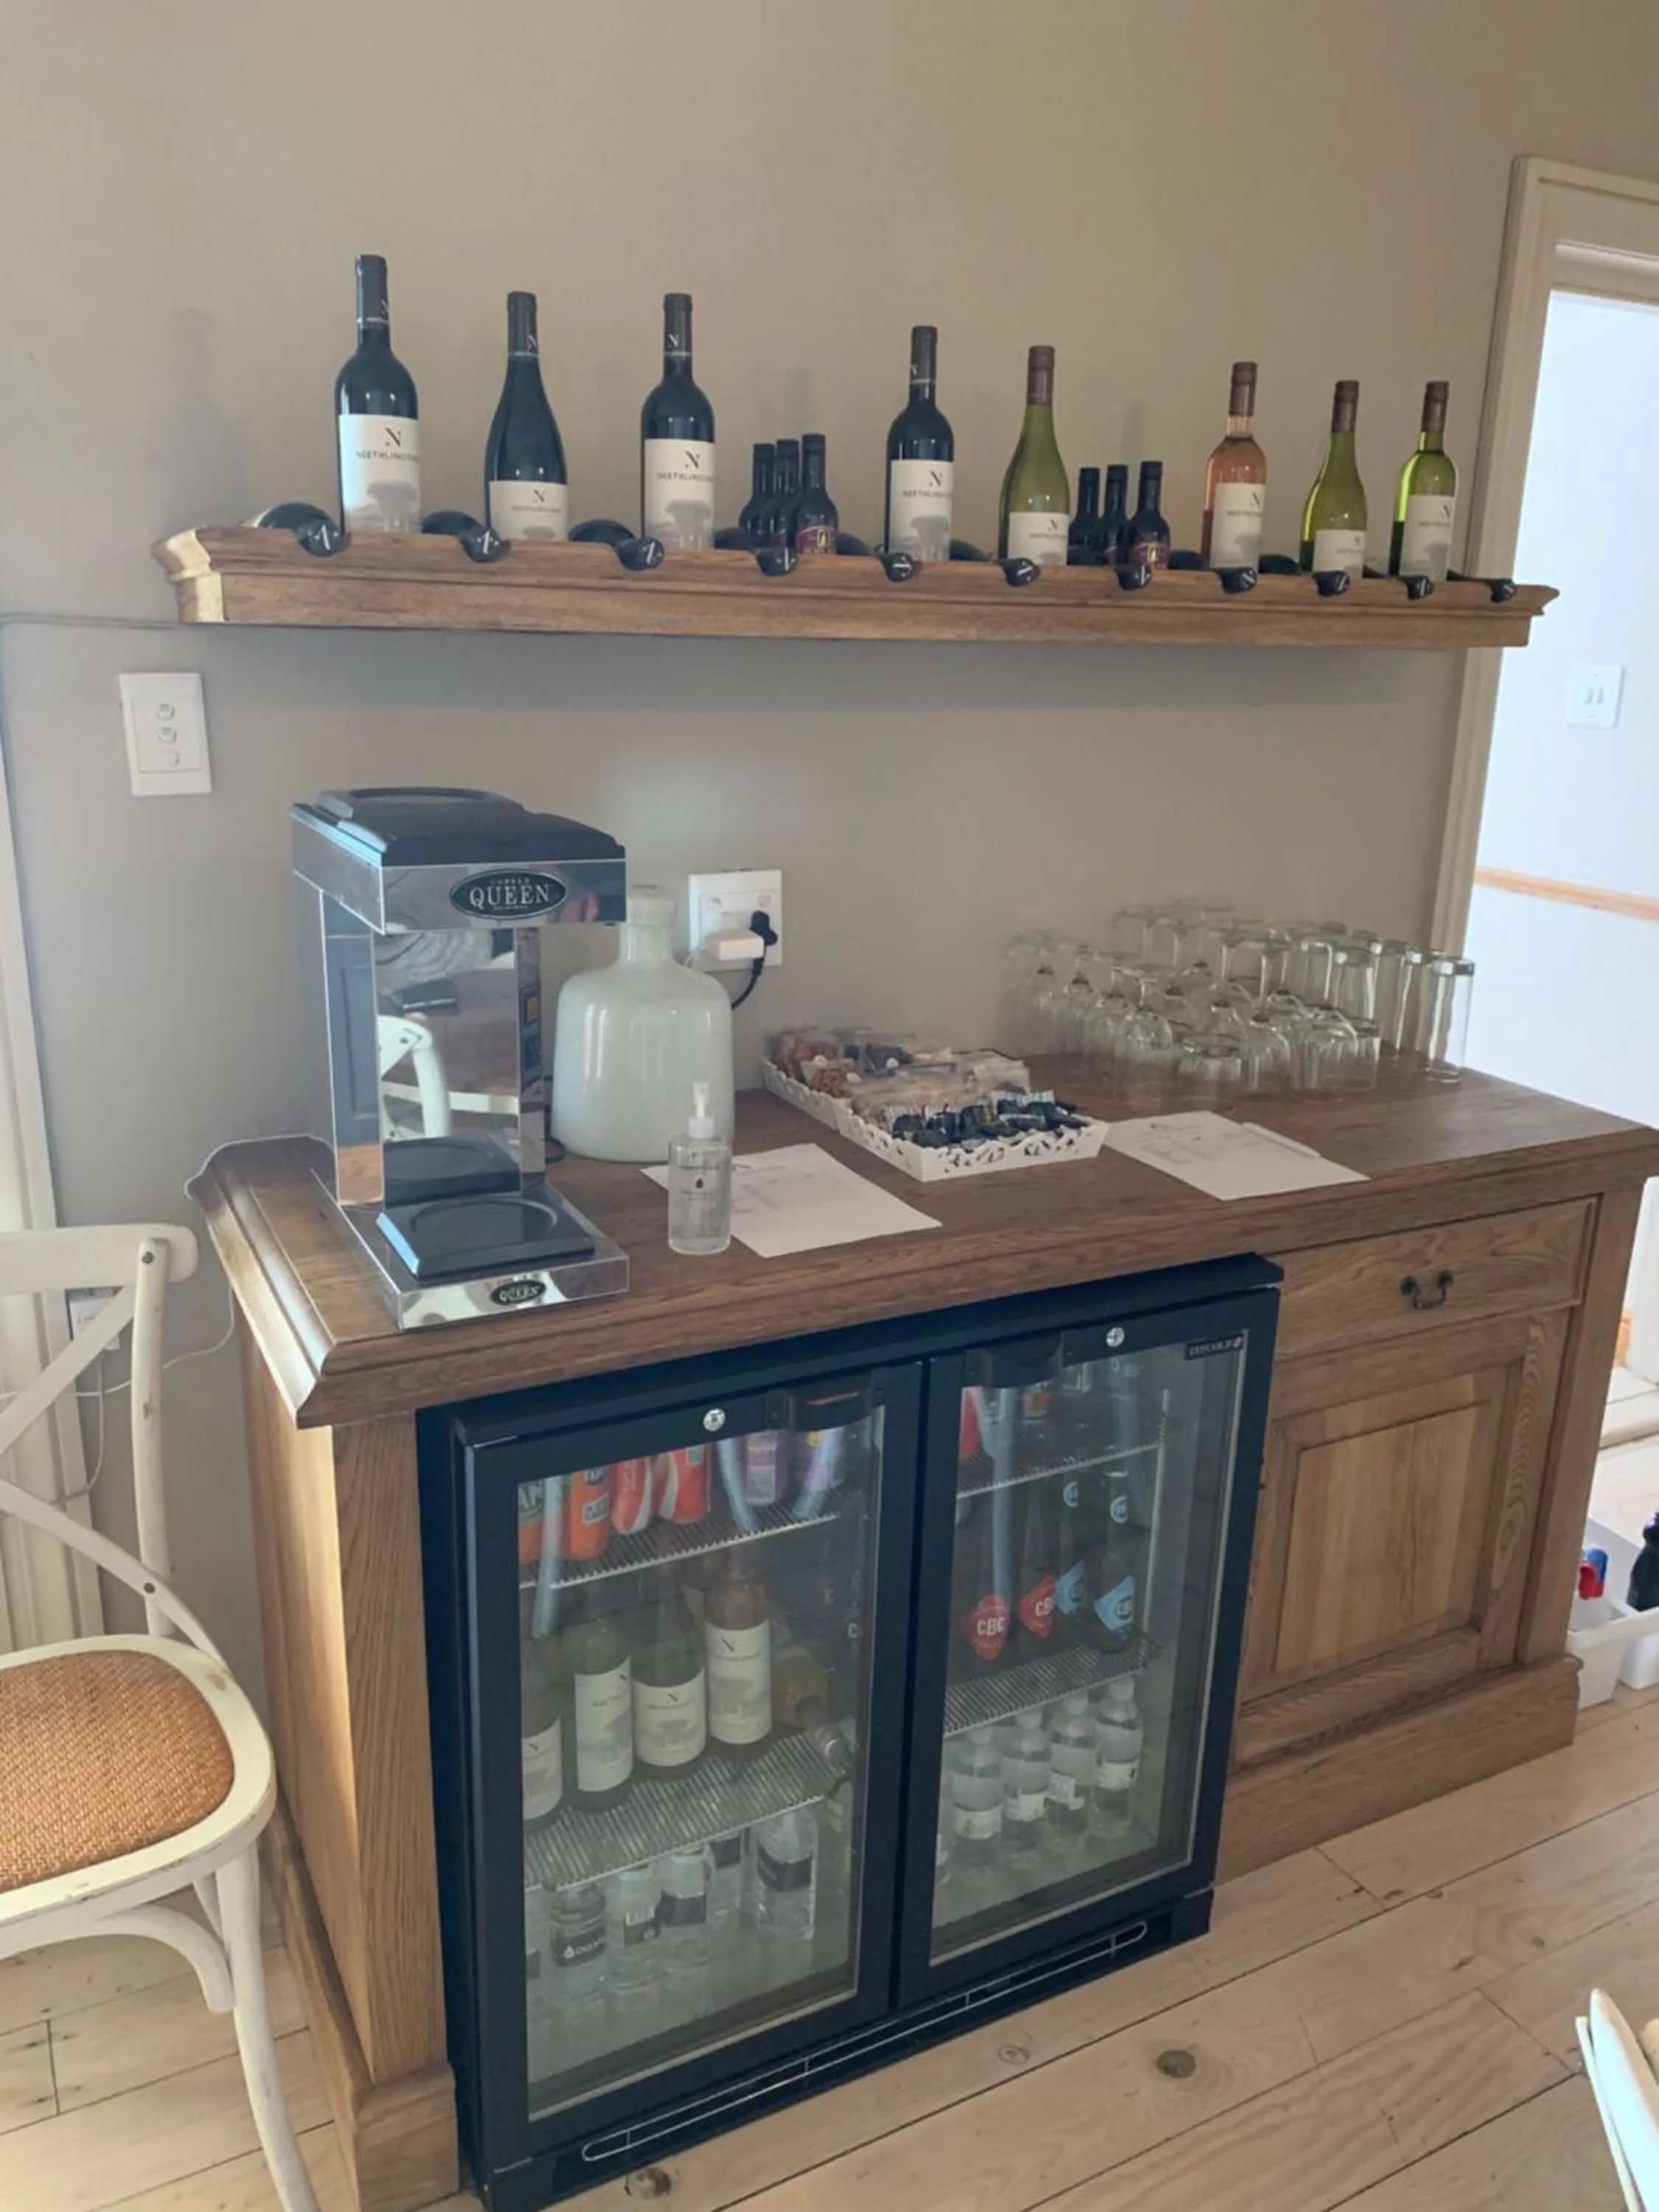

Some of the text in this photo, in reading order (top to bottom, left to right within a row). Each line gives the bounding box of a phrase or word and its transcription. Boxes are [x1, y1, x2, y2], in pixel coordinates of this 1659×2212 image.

[384, 426, 402, 448] N
[684, 450, 700, 468] N
[929, 470, 943, 487] N
[469, 884, 549, 911] QUEEN
[977, 1616, 1006, 1637] CBC
